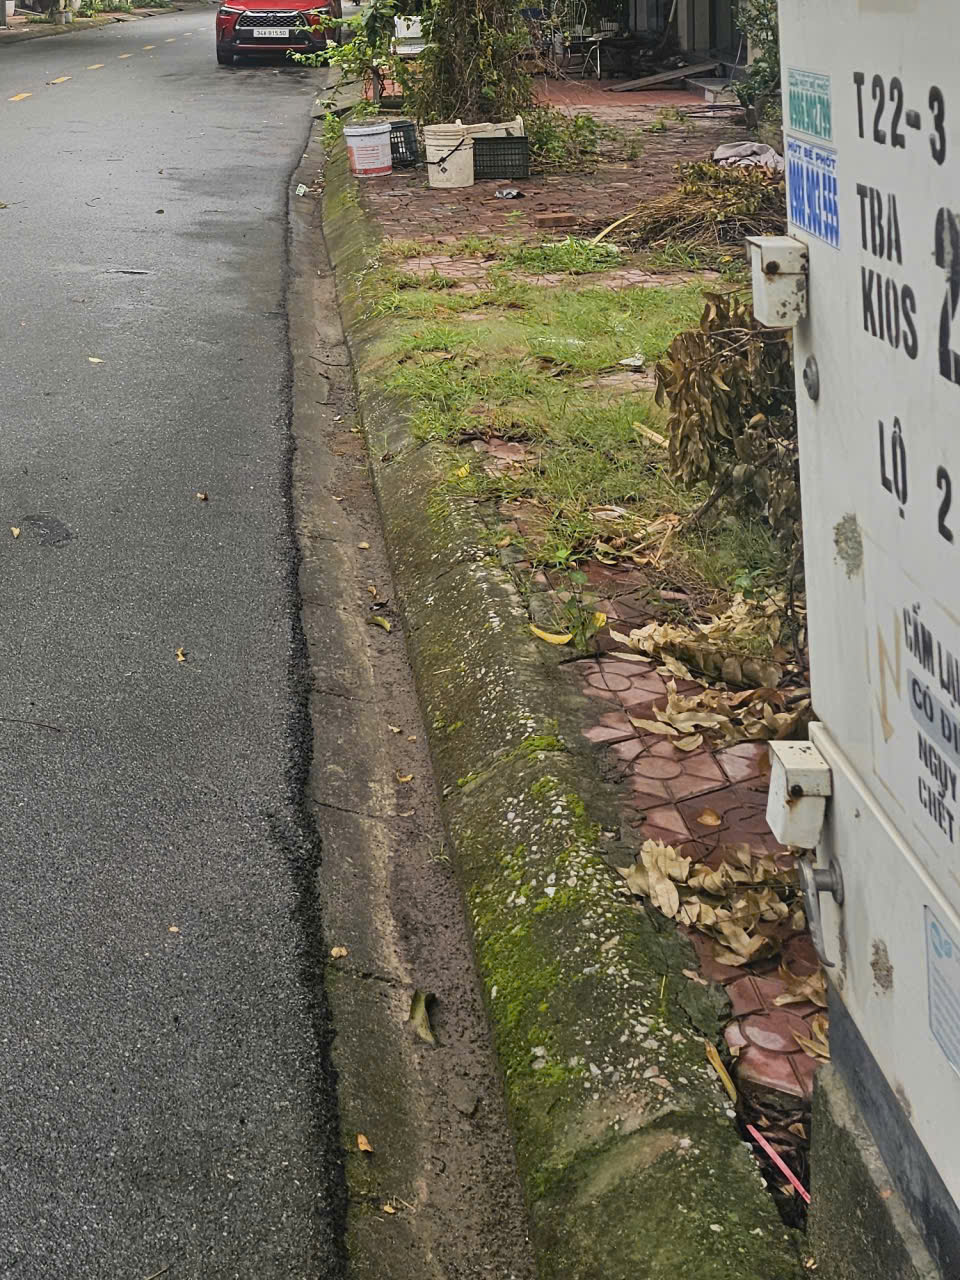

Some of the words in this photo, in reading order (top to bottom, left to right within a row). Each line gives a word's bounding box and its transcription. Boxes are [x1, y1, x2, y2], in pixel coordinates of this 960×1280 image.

[853, 71, 946, 166] T22-3
[856, 182, 903, 266] TBA
[861, 265, 919, 361] KIOS
[936, 464, 955, 546] 2
